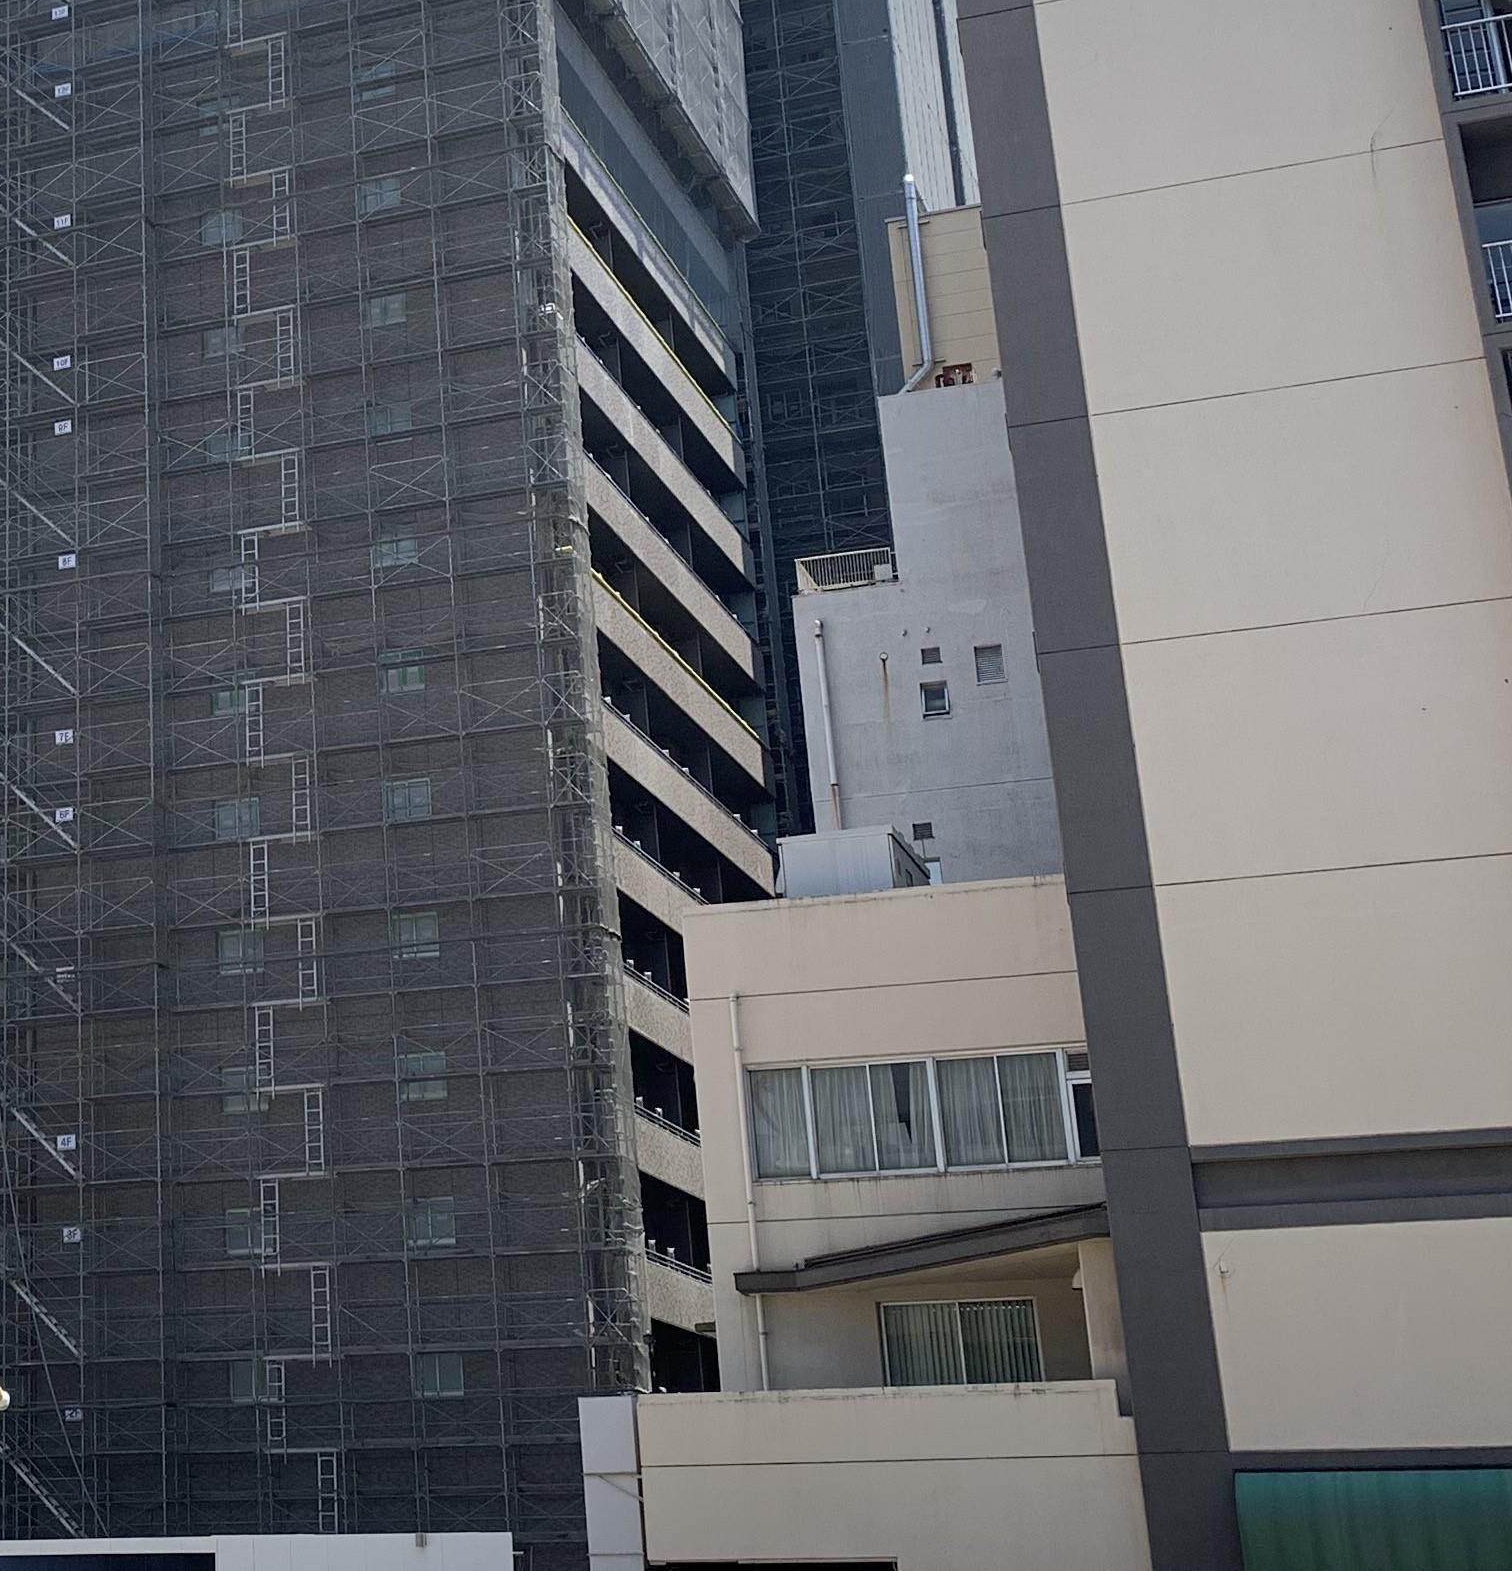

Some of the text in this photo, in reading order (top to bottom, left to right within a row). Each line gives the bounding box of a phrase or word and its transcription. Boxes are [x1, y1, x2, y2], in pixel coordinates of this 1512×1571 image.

[56, 217, 68, 226] 11F
[56, 358, 68, 367] 10F
[62, 556, 72, 566] 8F
[60, 1136, 72, 1146] 4F
[67, 1228, 78, 1239] 3F
